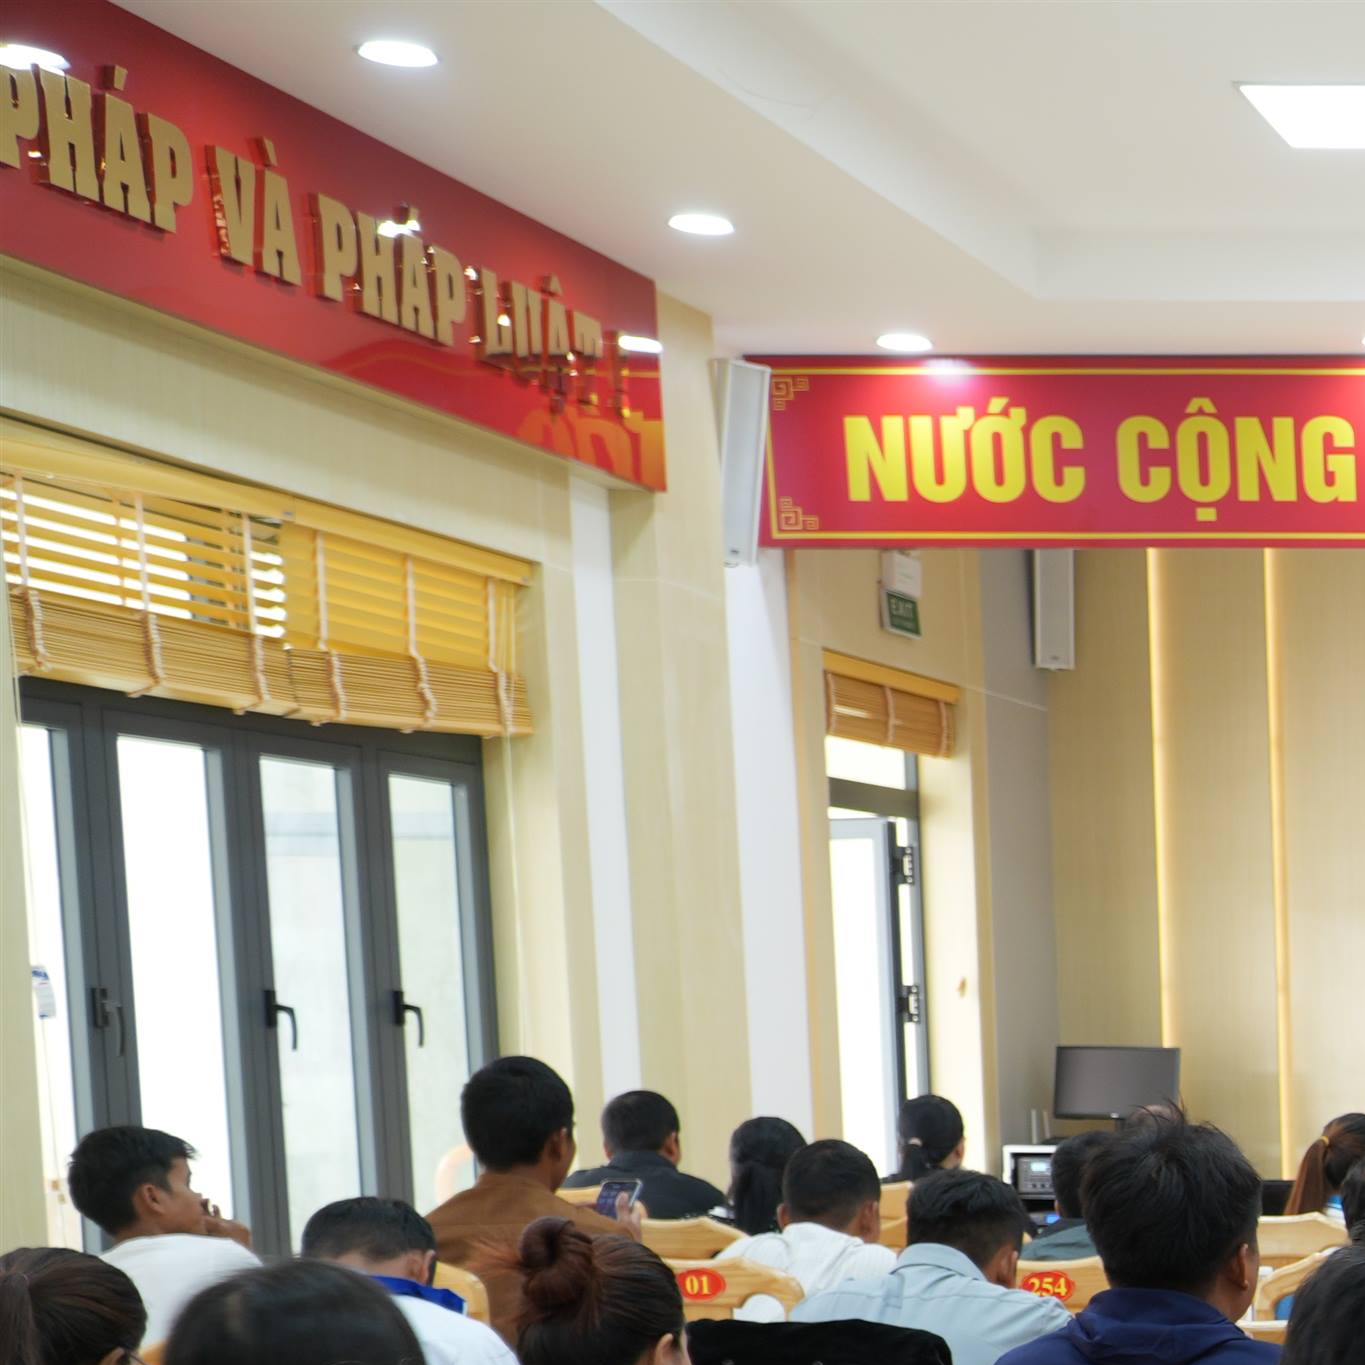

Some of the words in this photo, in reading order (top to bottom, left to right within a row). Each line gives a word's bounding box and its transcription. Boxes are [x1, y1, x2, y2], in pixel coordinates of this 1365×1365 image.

[0, 62, 194, 234] PHÁP
[212, 135, 302, 288] VÀ
[316, 192, 467, 348] PHÁP
[843, 396, 1086, 503] NƯỚC
[1116, 397, 1358, 521] CỘNG
[1029, 1277, 1067, 1297] 254
